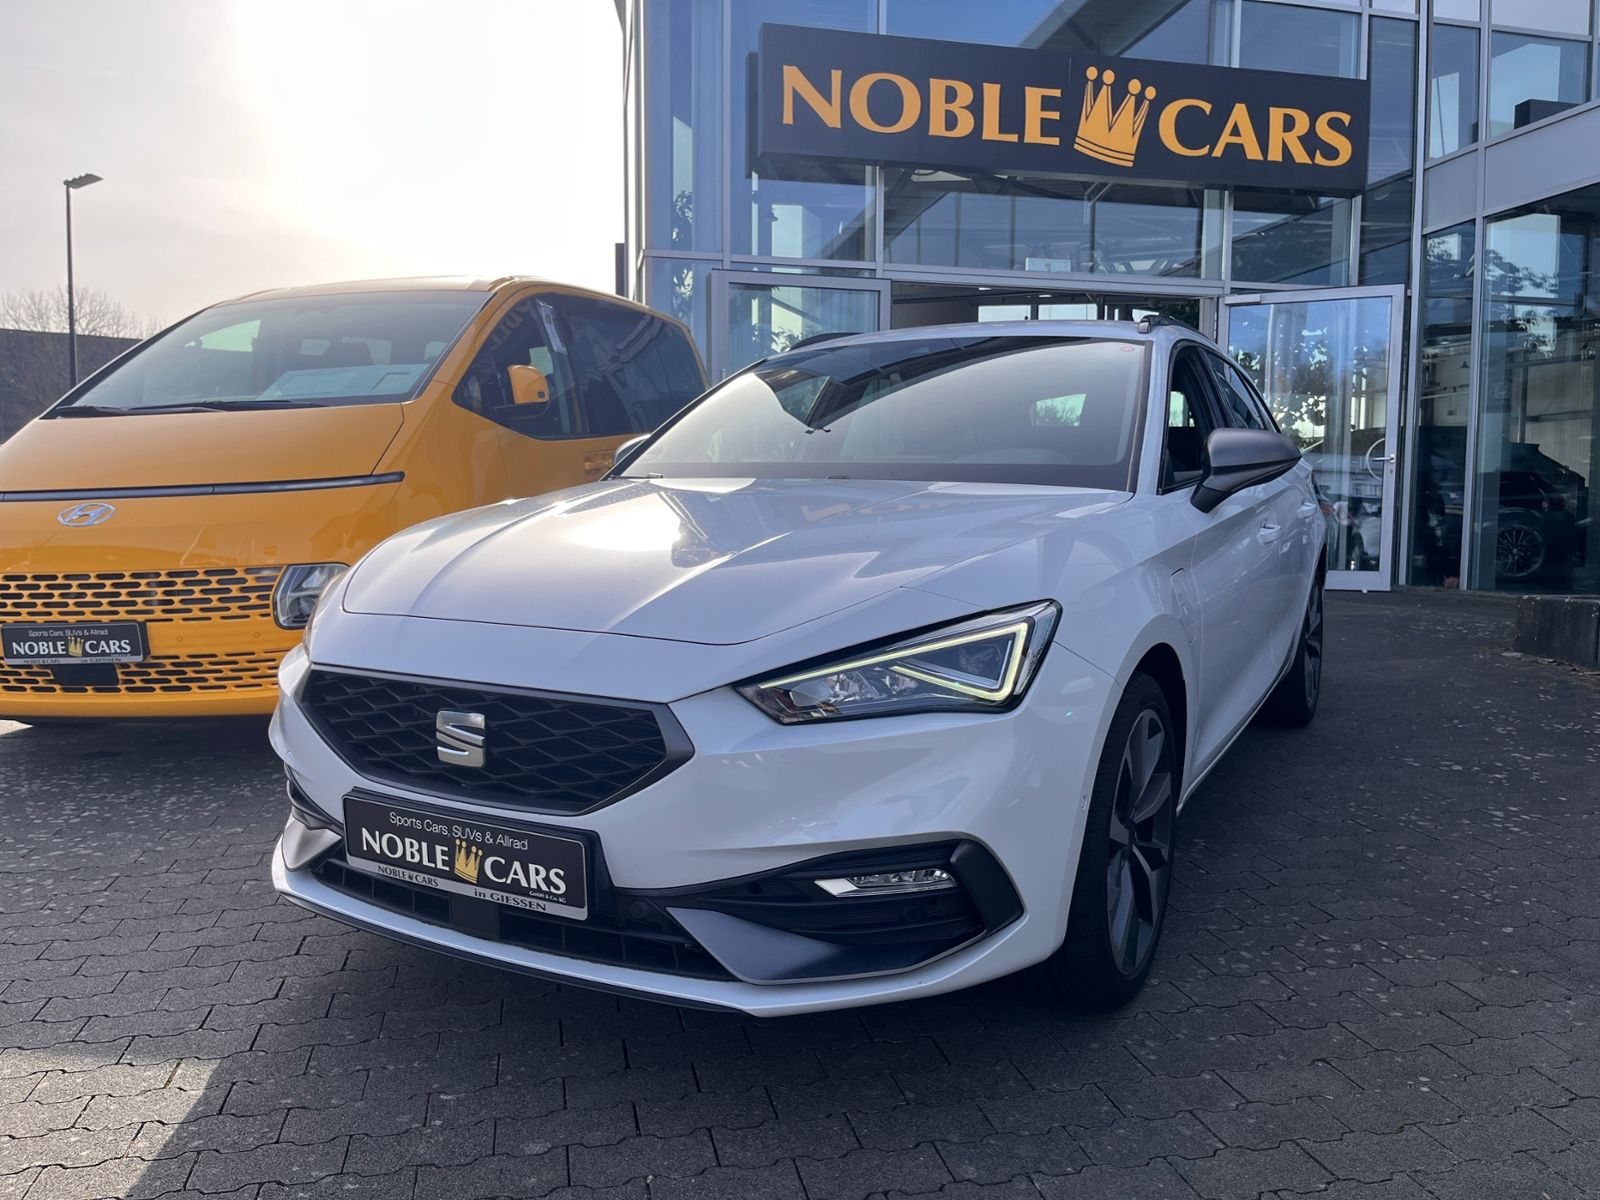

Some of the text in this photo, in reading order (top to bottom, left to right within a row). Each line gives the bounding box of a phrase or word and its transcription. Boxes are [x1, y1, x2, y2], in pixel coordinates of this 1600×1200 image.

[782, 64, 1353, 167] NOBLE CARS
[12, 639, 132, 655] NOBLE CARS
[28, 629, 49, 637] Sports
[389, 811, 422, 829] Sports
[452, 825, 483, 843] SUVs
[484, 831, 494, 844] &
[496, 834, 528, 850] Allrad
[361, 827, 567, 895] NOBLE CARS
[377, 865, 547, 912] NOBLE CARS in GIESSEN
